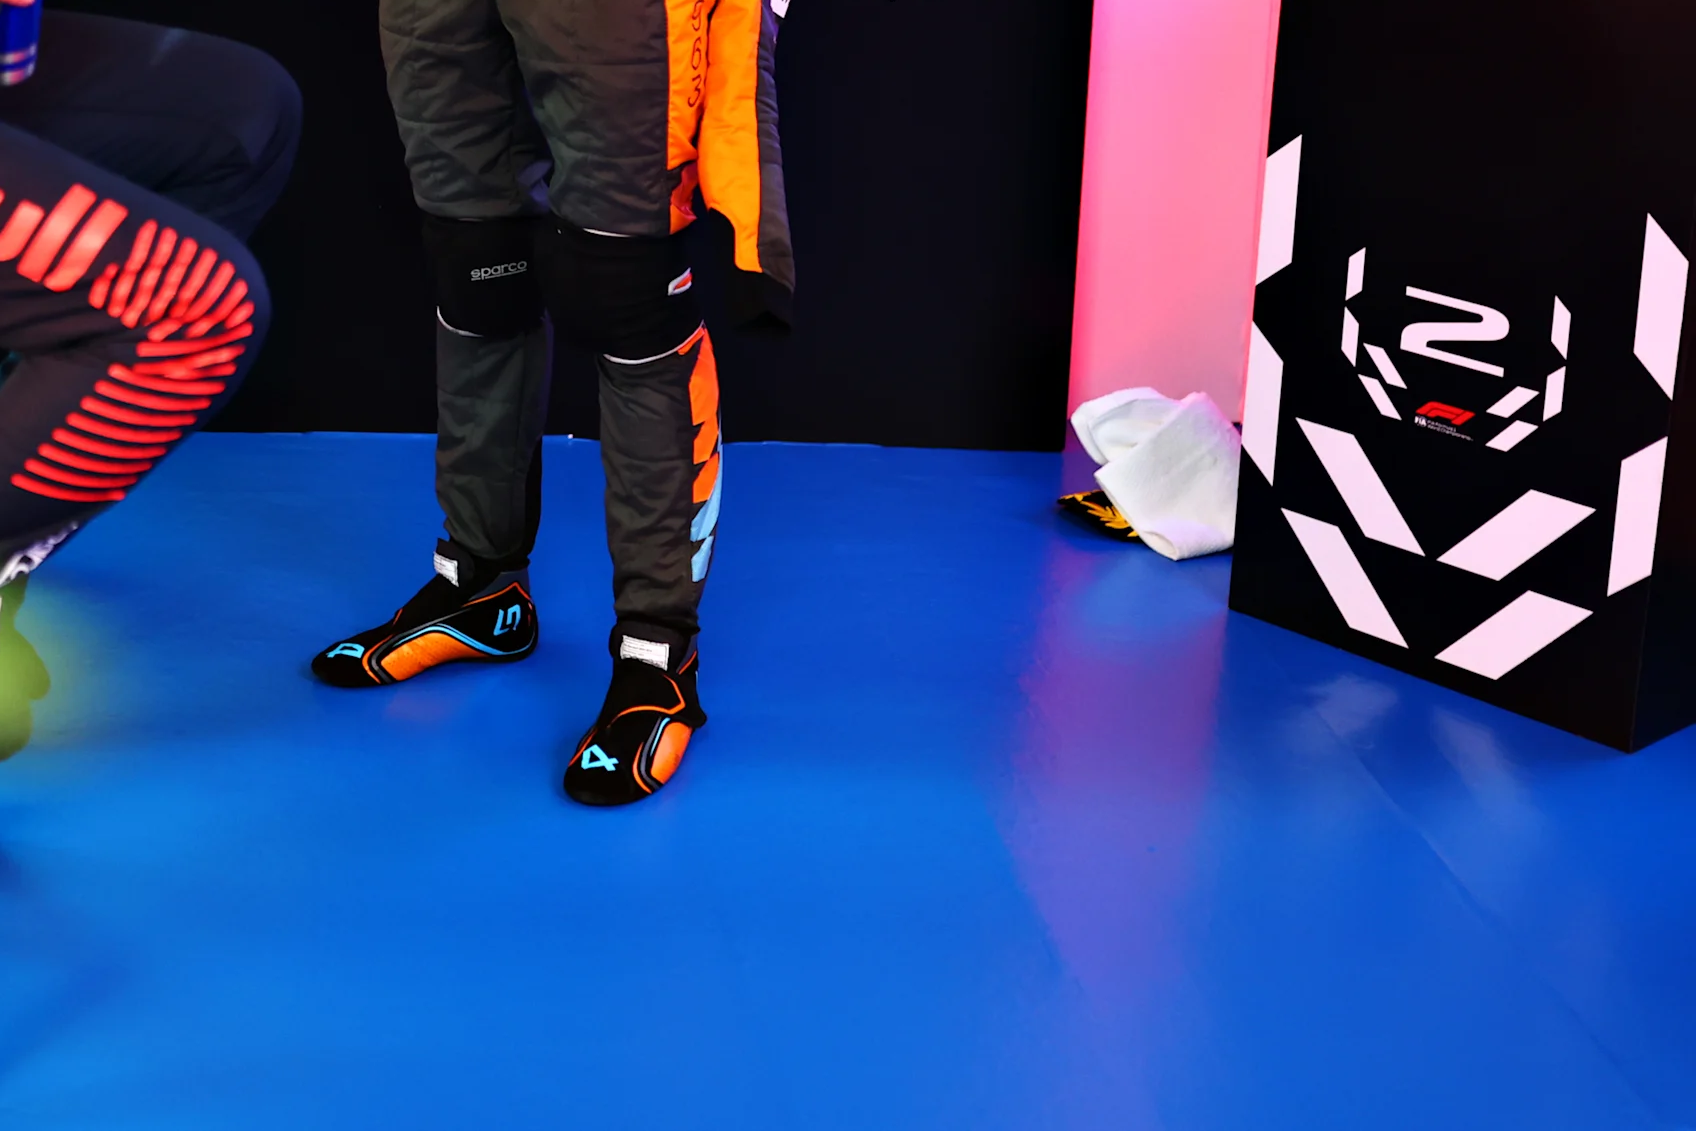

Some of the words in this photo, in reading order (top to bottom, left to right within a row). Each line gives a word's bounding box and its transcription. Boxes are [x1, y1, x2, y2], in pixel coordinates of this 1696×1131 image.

[470, 261, 528, 281] sparco
[1400, 285, 1510, 377] 2
[580, 744, 619, 772] 4
